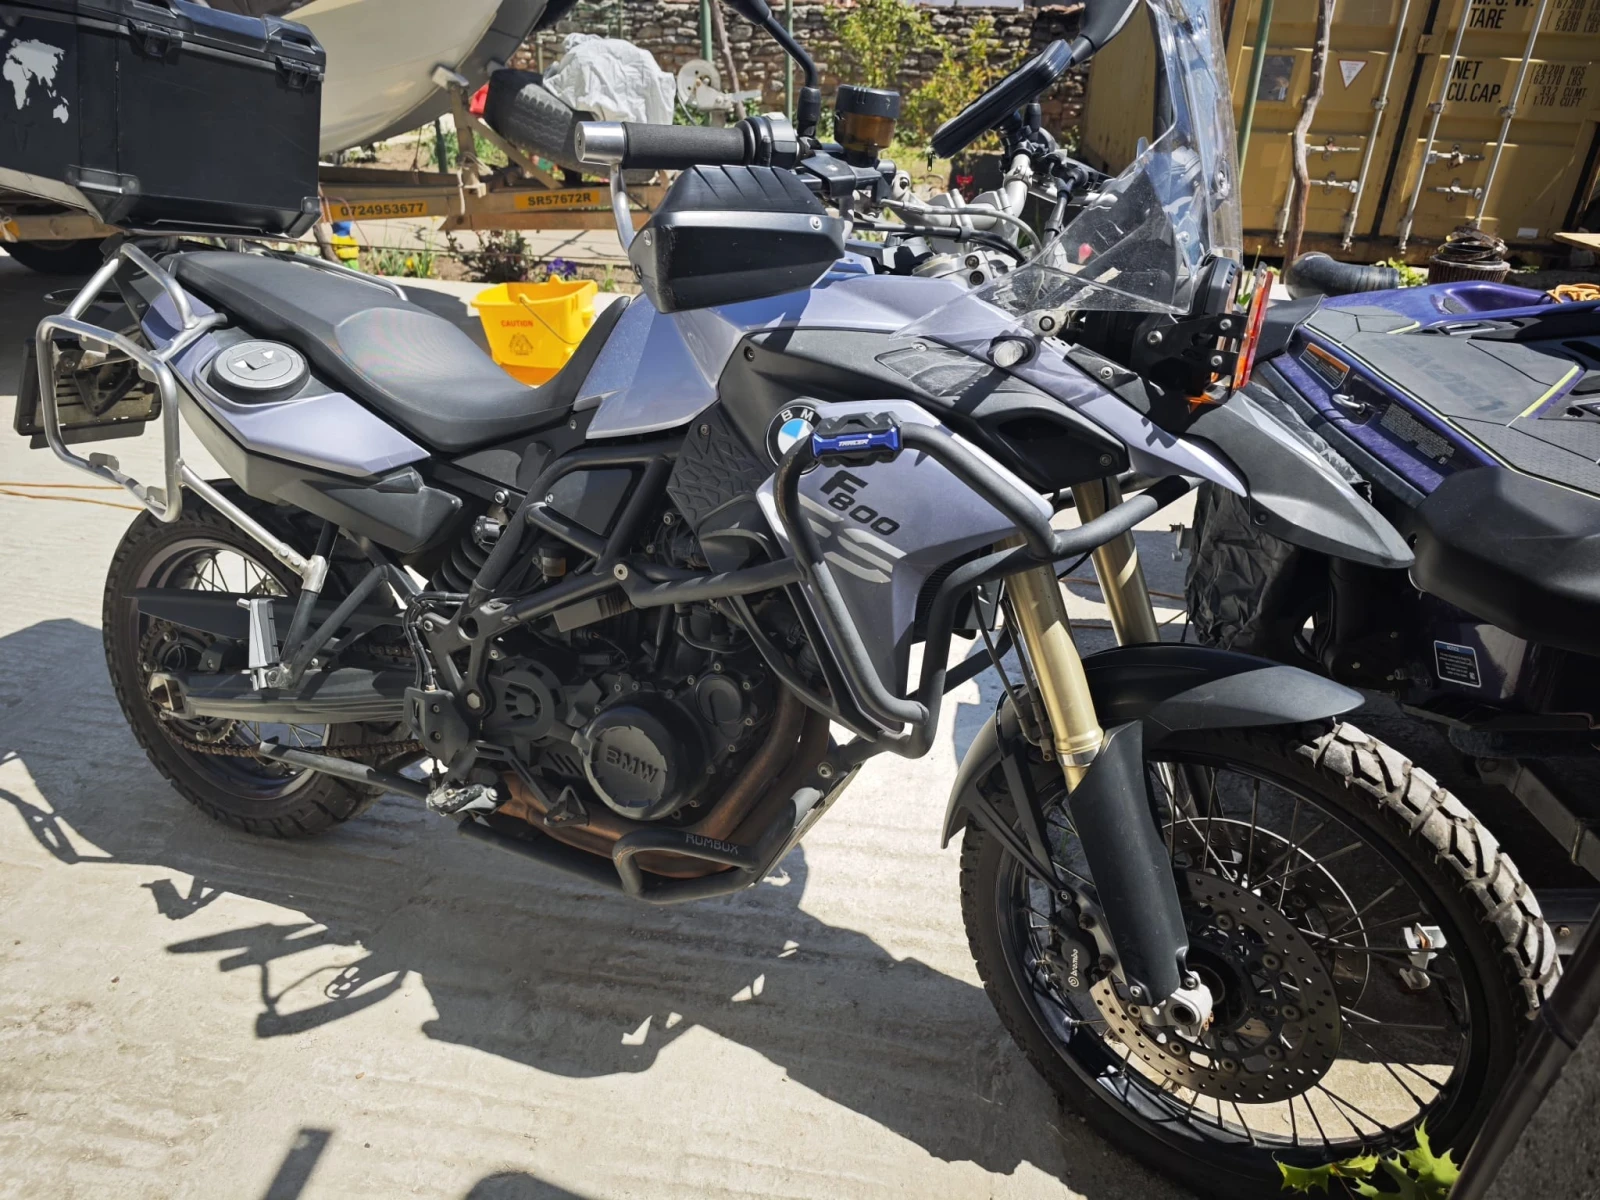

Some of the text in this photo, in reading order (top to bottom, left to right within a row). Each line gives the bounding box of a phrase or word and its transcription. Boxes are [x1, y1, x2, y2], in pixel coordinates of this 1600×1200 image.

[1468, 8, 1506, 29] TARE
[1452, 61, 1483, 80] NET
[1570, 66, 1587, 77] KGS
[1566, 75, 1583, 86] LBS
[1446, 82, 1502, 103] CU.CAP.
[527, 192, 592, 206] SR57672R
[340, 203, 424, 216] 0724953677
[500, 319, 534, 328] CAUTION
[819, 469, 868, 495] F
[827, 492, 900, 536] 800
[605, 745, 659, 783] BMW
